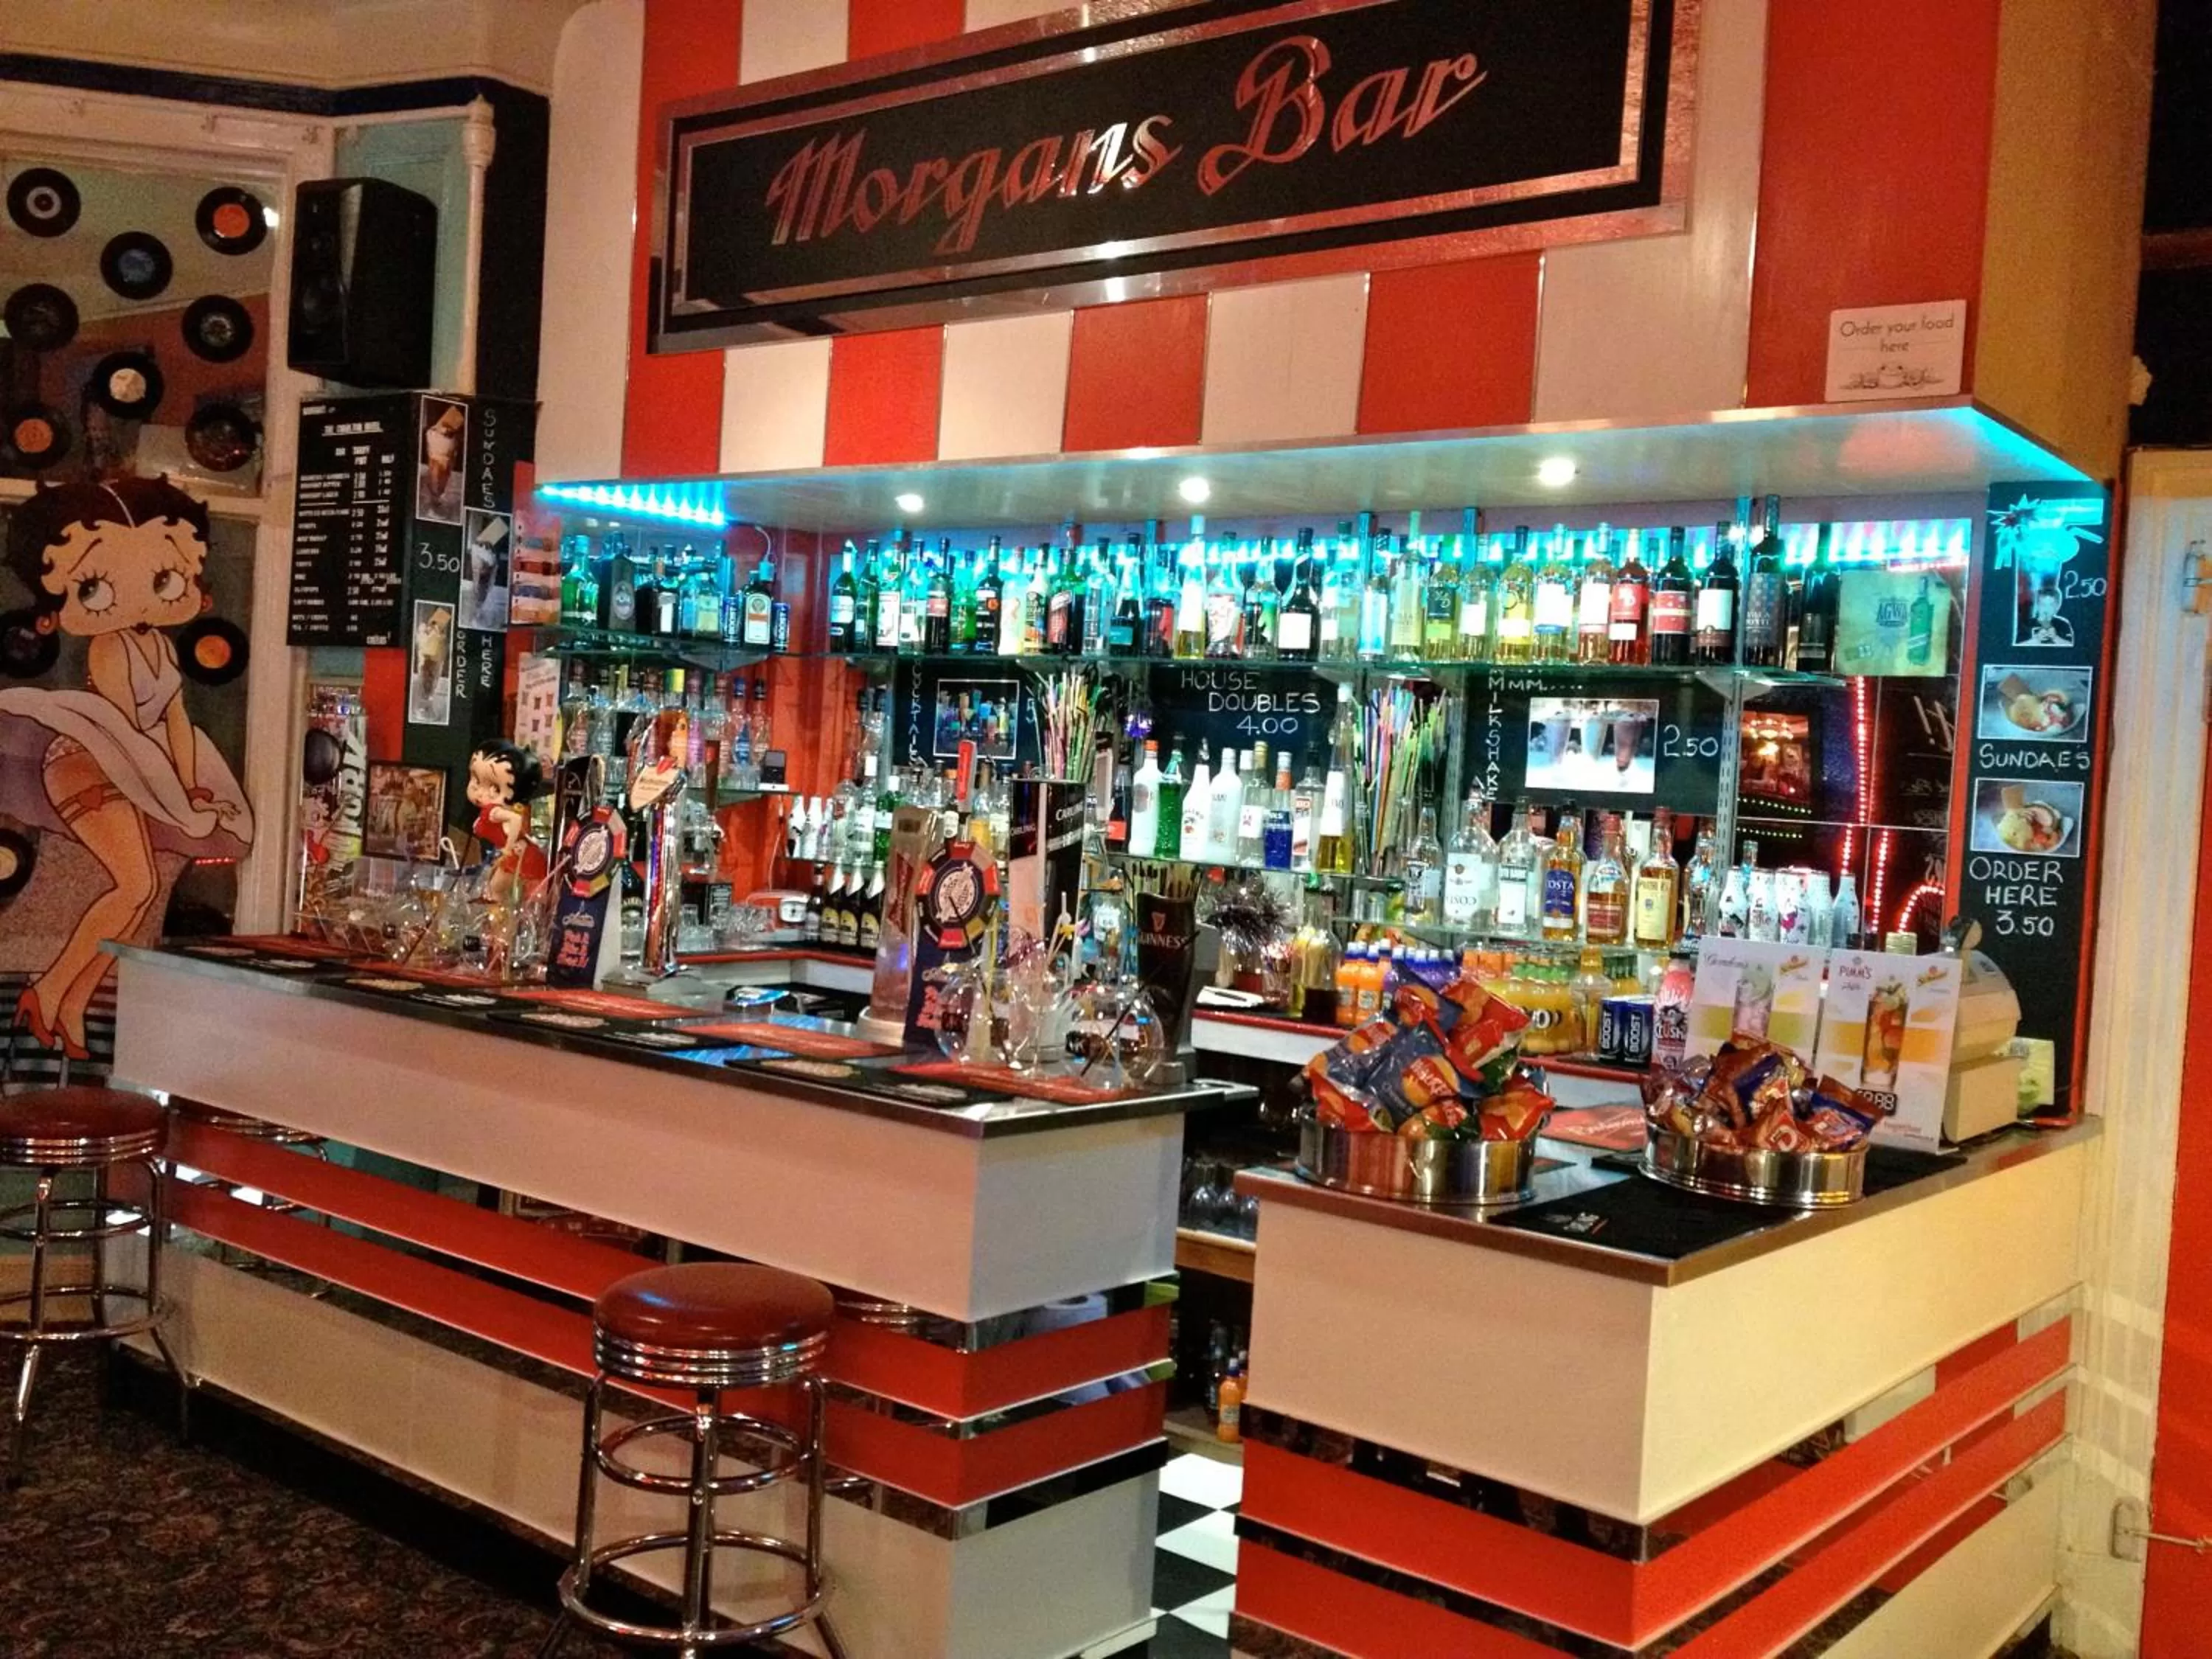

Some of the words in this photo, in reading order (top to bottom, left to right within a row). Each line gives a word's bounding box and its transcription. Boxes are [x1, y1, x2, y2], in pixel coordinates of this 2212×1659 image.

[766, 114, 1182, 256] Morgans
[1198, 36, 1488, 196] Bar
[1840, 321, 1882, 337] Order
[1887, 321, 1916, 336] your
[1921, 313, 1954, 330] food
[1881, 340, 1910, 352] here
[418, 541, 460, 573] 3.50
[456, 630, 467, 698] ORDER
[480, 636, 493, 688] HERE
[1180, 669, 1261, 691] HOUSE
[1208, 692, 1321, 714] DOUBLES
[1236, 714, 1299, 736] 4.00
[1485, 676, 1505, 801] MILKSHAKE
[1663, 723, 1719, 758] 2.50
[1979, 743, 2090, 769] SUNDAES
[1969, 856, 2064, 883] ORDER
[1985, 885, 2058, 907] HERE
[1995, 911, 2055, 937] 3.50
[1138, 931, 1190, 951] UINNESS
[1601, 1010, 1613, 1050] BOOST
[1629, 1014, 1641, 1054] BOOST
